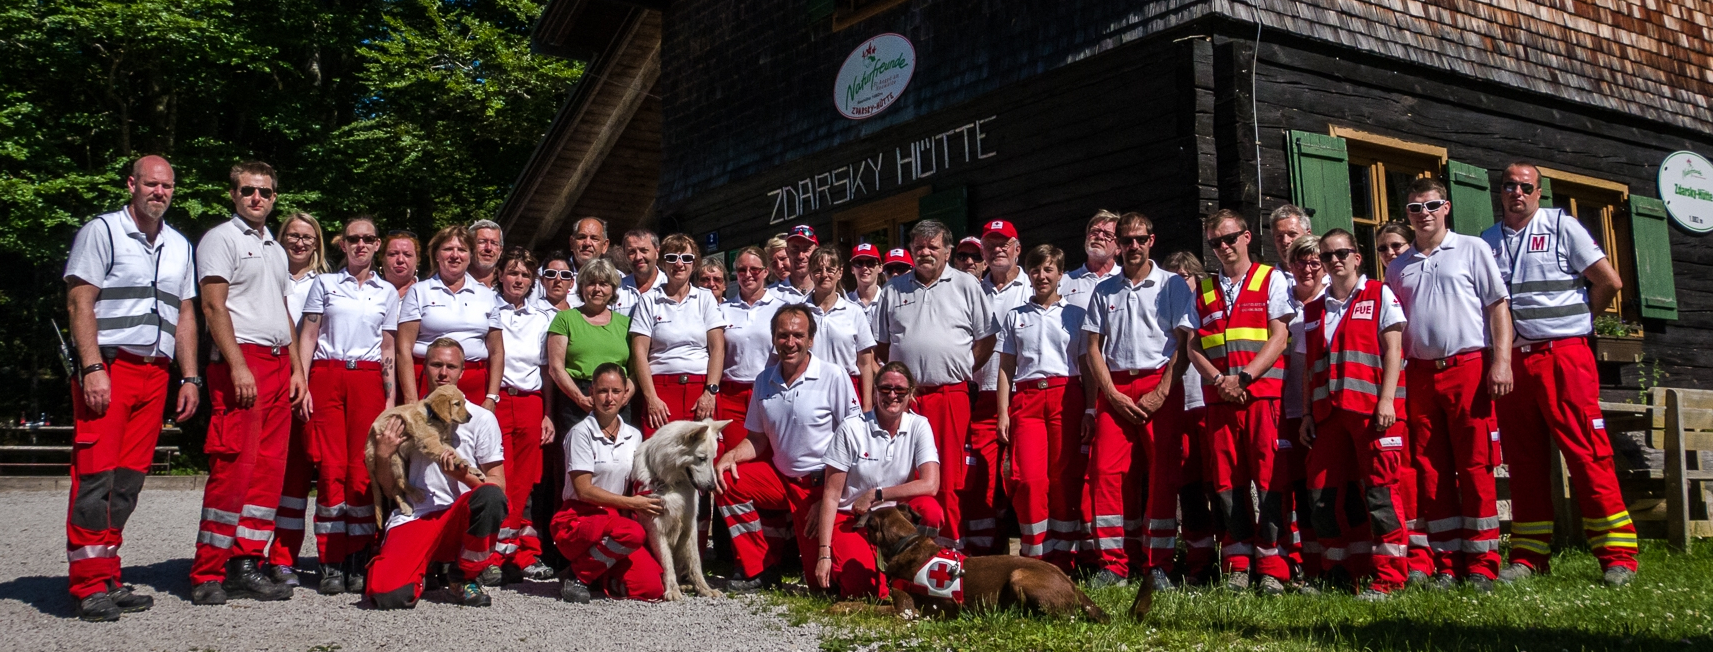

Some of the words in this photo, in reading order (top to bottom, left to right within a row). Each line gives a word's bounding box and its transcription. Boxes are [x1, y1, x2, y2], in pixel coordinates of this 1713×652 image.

[845, 52, 908, 110] Naturfreunde
[767, 152, 883, 225] ZDARSKY
[896, 115, 997, 185] HÜTTE
[1531, 236, 1546, 251] M
[1354, 305, 1372, 315] FUE
